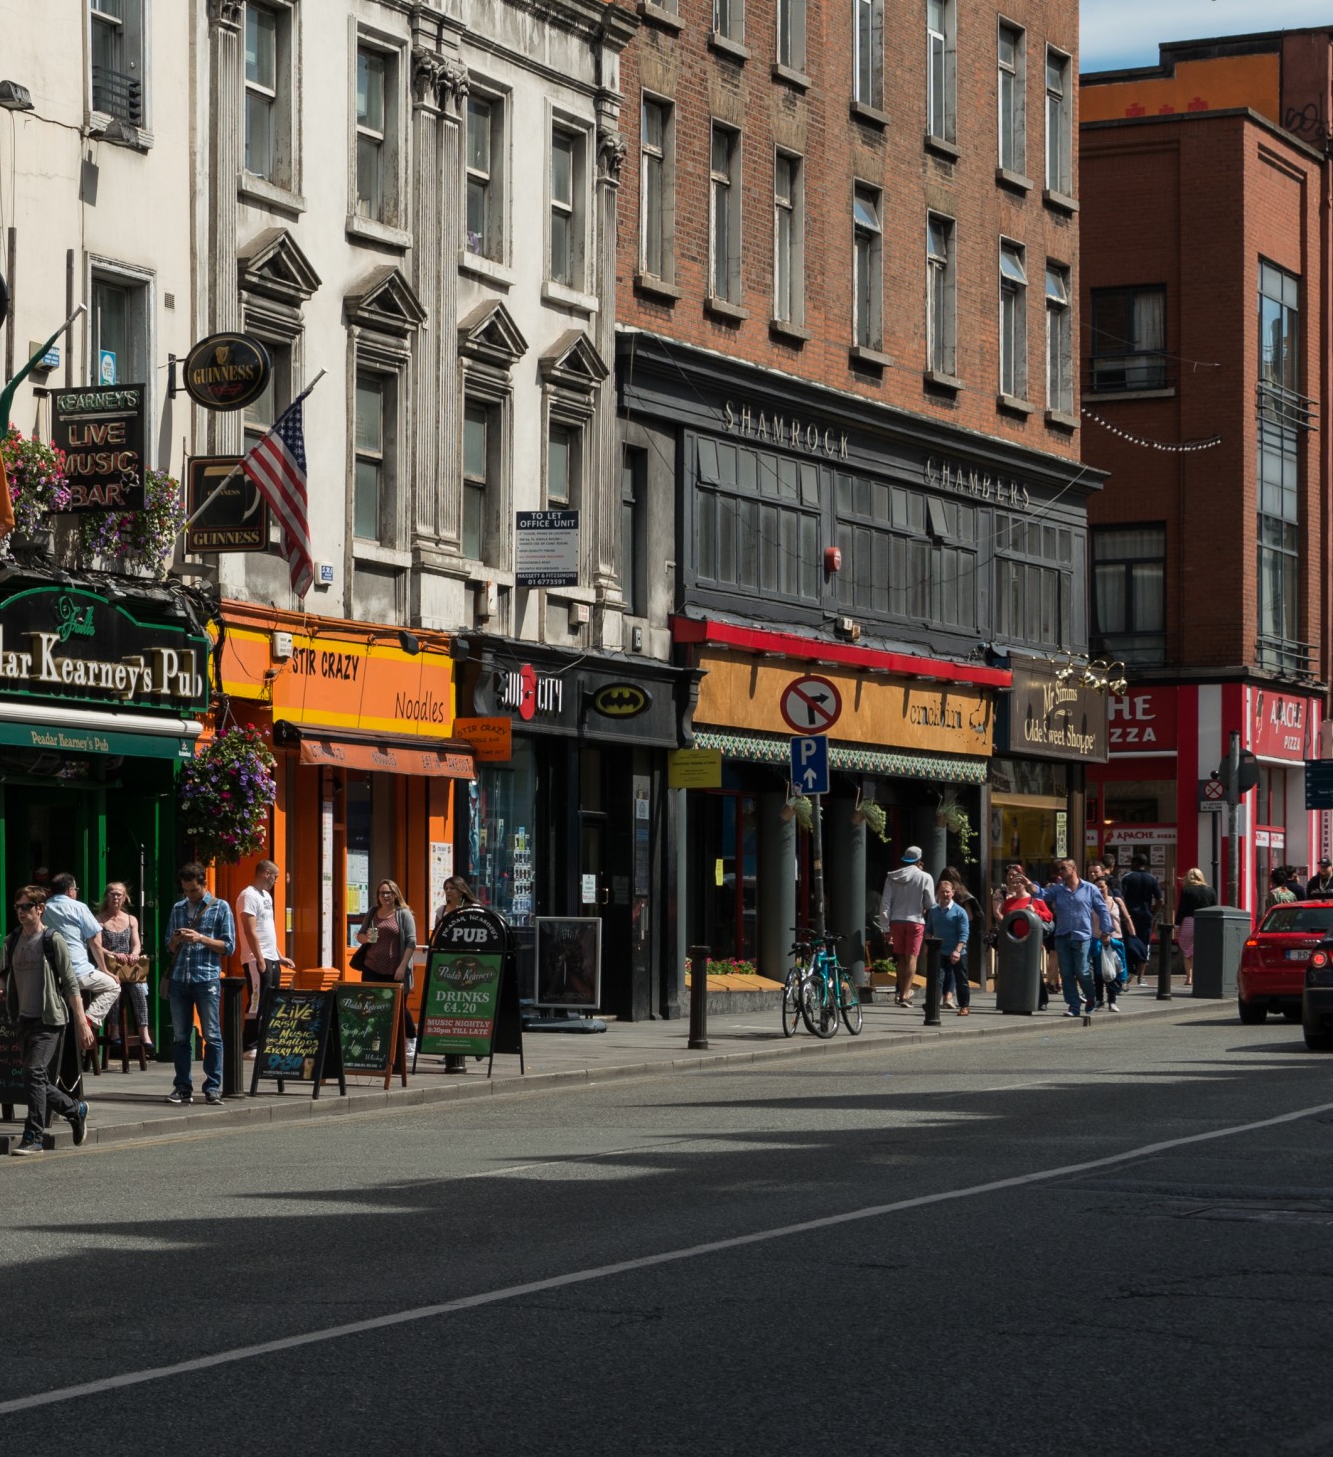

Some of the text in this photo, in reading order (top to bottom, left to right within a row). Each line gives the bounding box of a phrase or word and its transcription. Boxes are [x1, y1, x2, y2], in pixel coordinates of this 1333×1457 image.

[193, 364, 255, 385] GUINNESS
[56, 390, 140, 412] KEARNEY'S
[69, 422, 126, 447] LIVE
[724, 399, 849, 460] SHAMROCK
[62, 451, 139, 476] MUSIC
[924, 455, 1030, 509] CHAMBERS
[69, 484, 125, 507] BAR
[519, 519, 575, 528] OFFICE UNIT
[193, 531, 260, 545] GUINNESS
[39, 632, 153, 698] Kearney's
[160, 648, 203, 698] Pub
[293, 647, 359, 681] STIR CRAZY
[395, 691, 445, 724] Noodles
[1043, 680, 1078, 719] Mr Simms
[31, 731, 109, 751] Peadar Kearney's Pub
[457, 724, 507, 737] STIR CRAZY
[1024, 719, 1043, 743] Olde
[1067, 725, 1095, 754] Shoppe
[801, 739, 817, 765] P
[1283, 735, 1301, 751] PIZZA
[451, 928, 488, 943] PUB
[438, 966, 493, 983] Peadar Kearney's
[435, 991, 490, 1003] DRINKS
[443, 1003, 477, 1013] €4.20
[427, 1019, 491, 1028] MUSIC NIGHTLY
